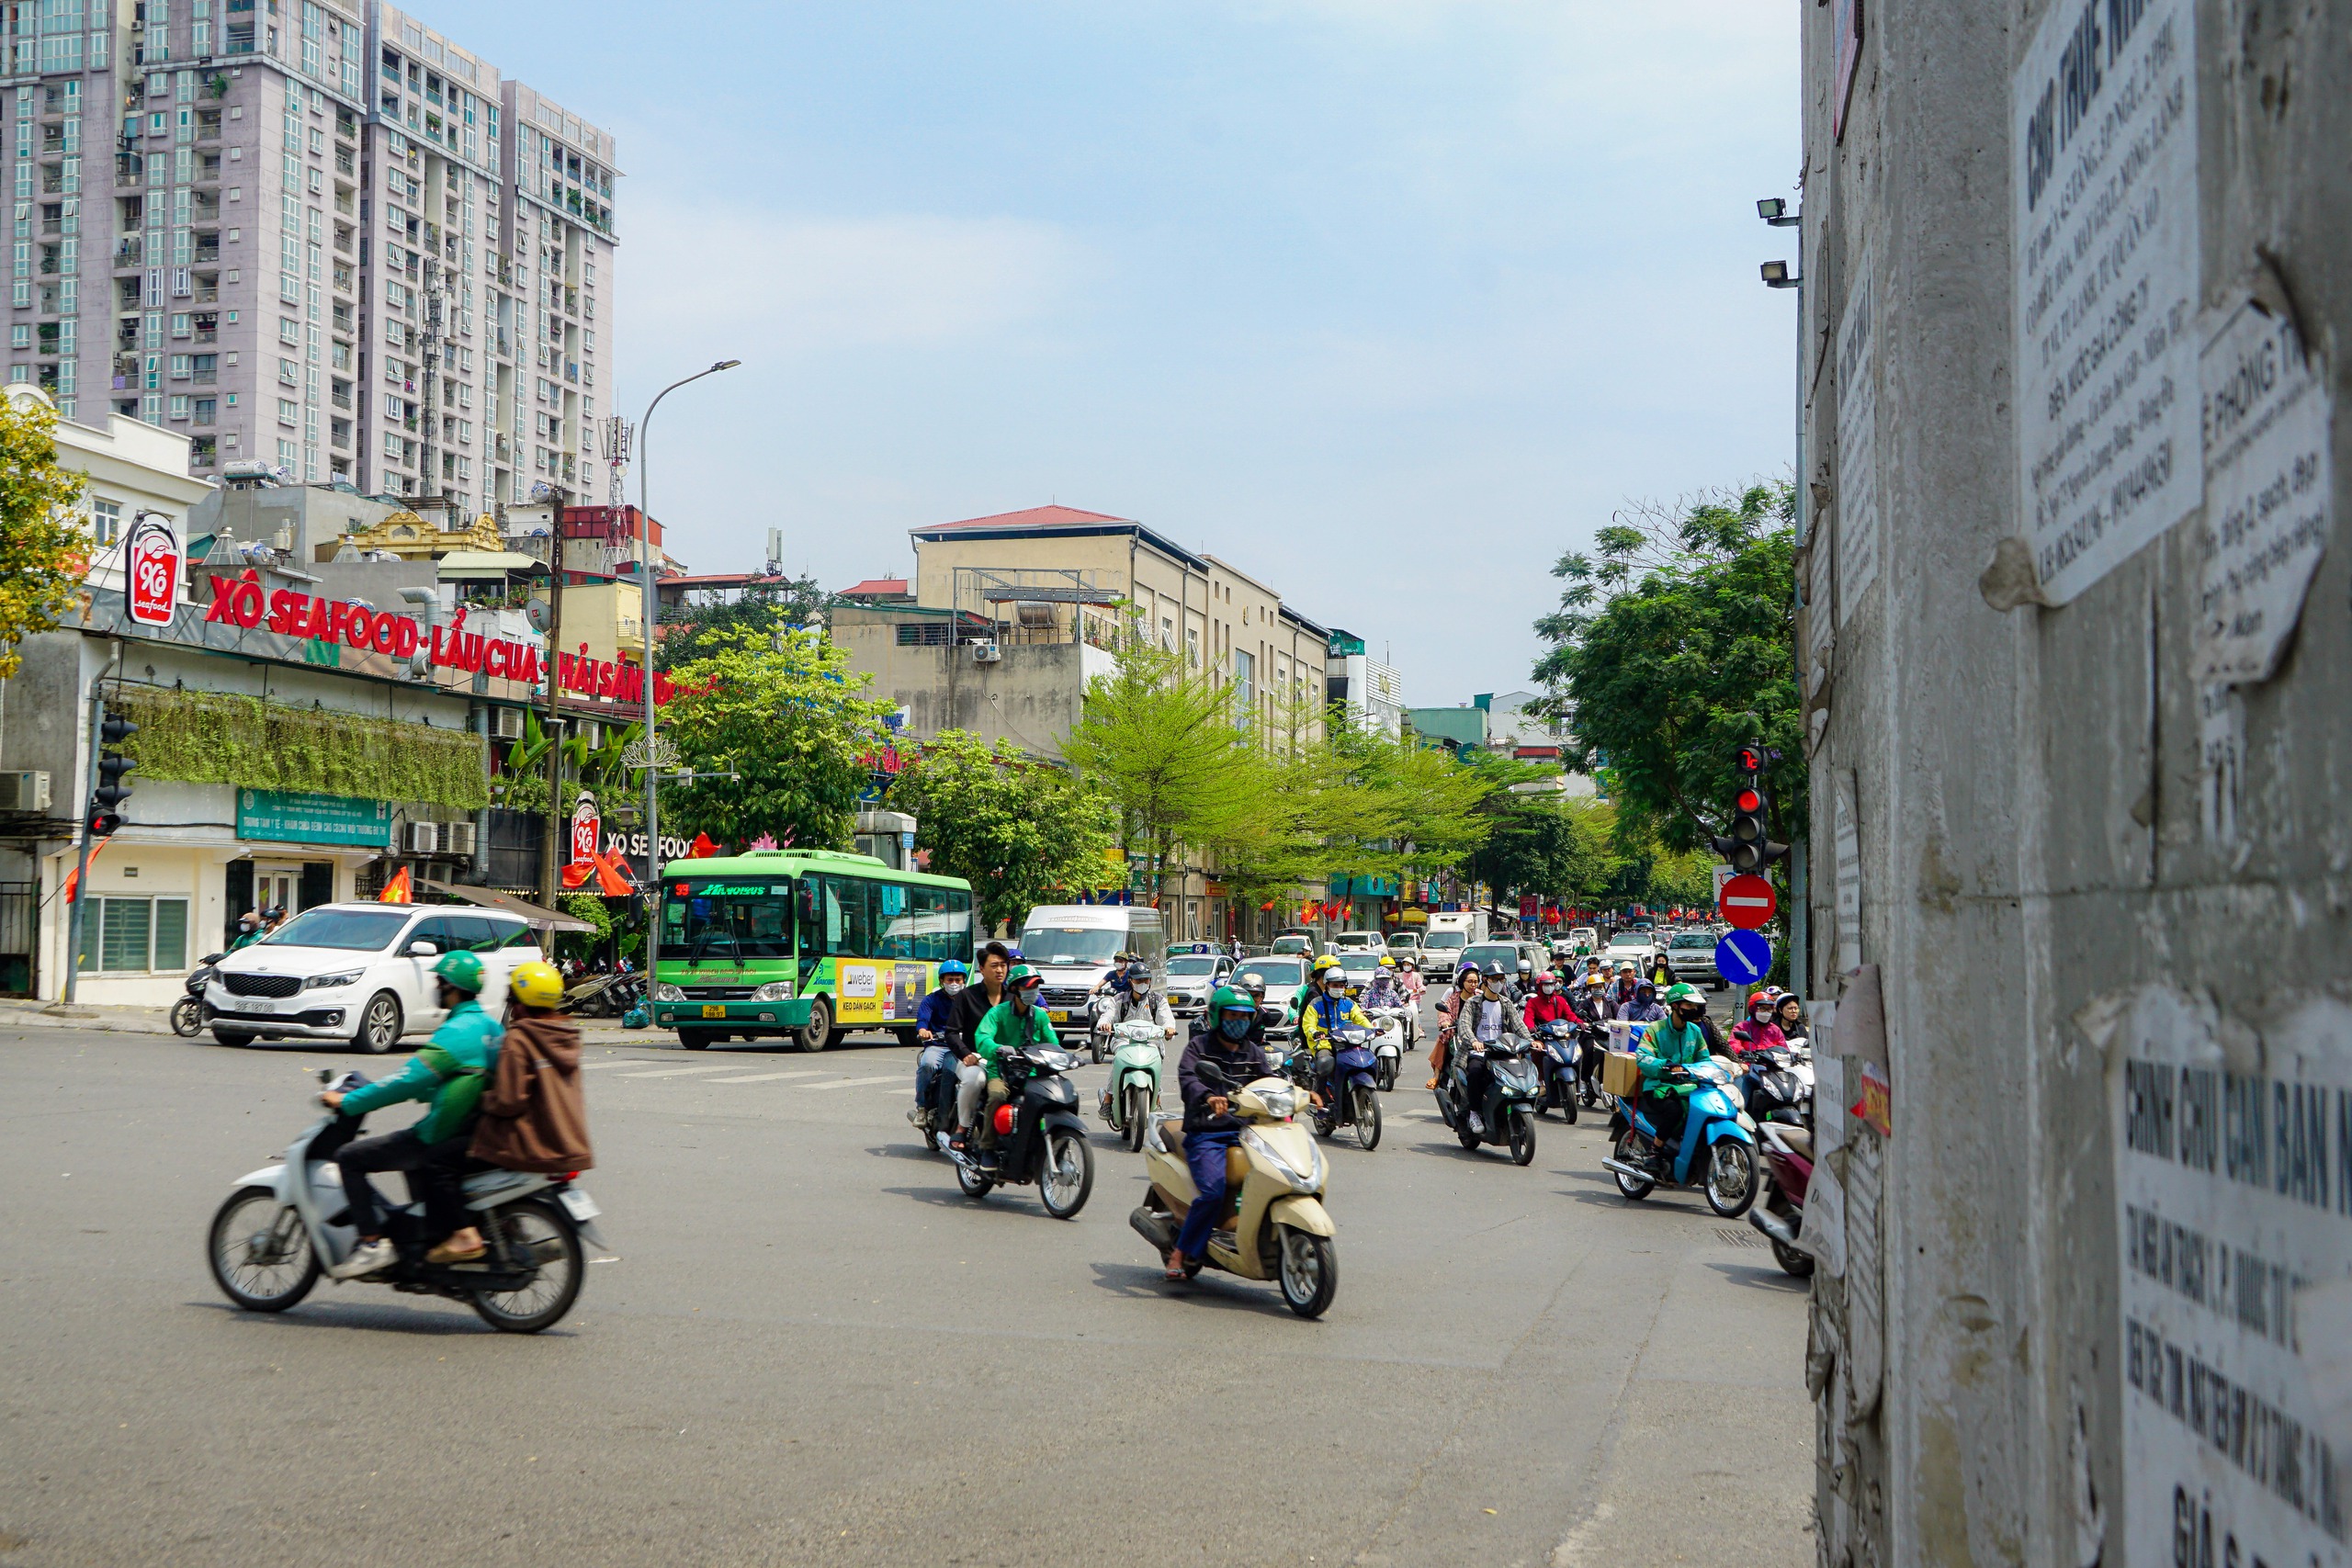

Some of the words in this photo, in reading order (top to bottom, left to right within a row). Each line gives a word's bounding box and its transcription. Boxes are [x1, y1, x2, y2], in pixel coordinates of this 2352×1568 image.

[135, 599, 170, 615] seafood
[205, 569, 264, 629] XÔ
[268, 589, 418, 658] SEAFOOD
[430, 607, 484, 673] LẨU
[483, 637, 539, 684] CUA
[558, 642, 599, 695] HẢI
[598, 649, 645, 704] SẢN
[630, 833, 693, 858] SEFOO
[675, 884, 690, 896] 99
[852, 971, 874, 986] weber
